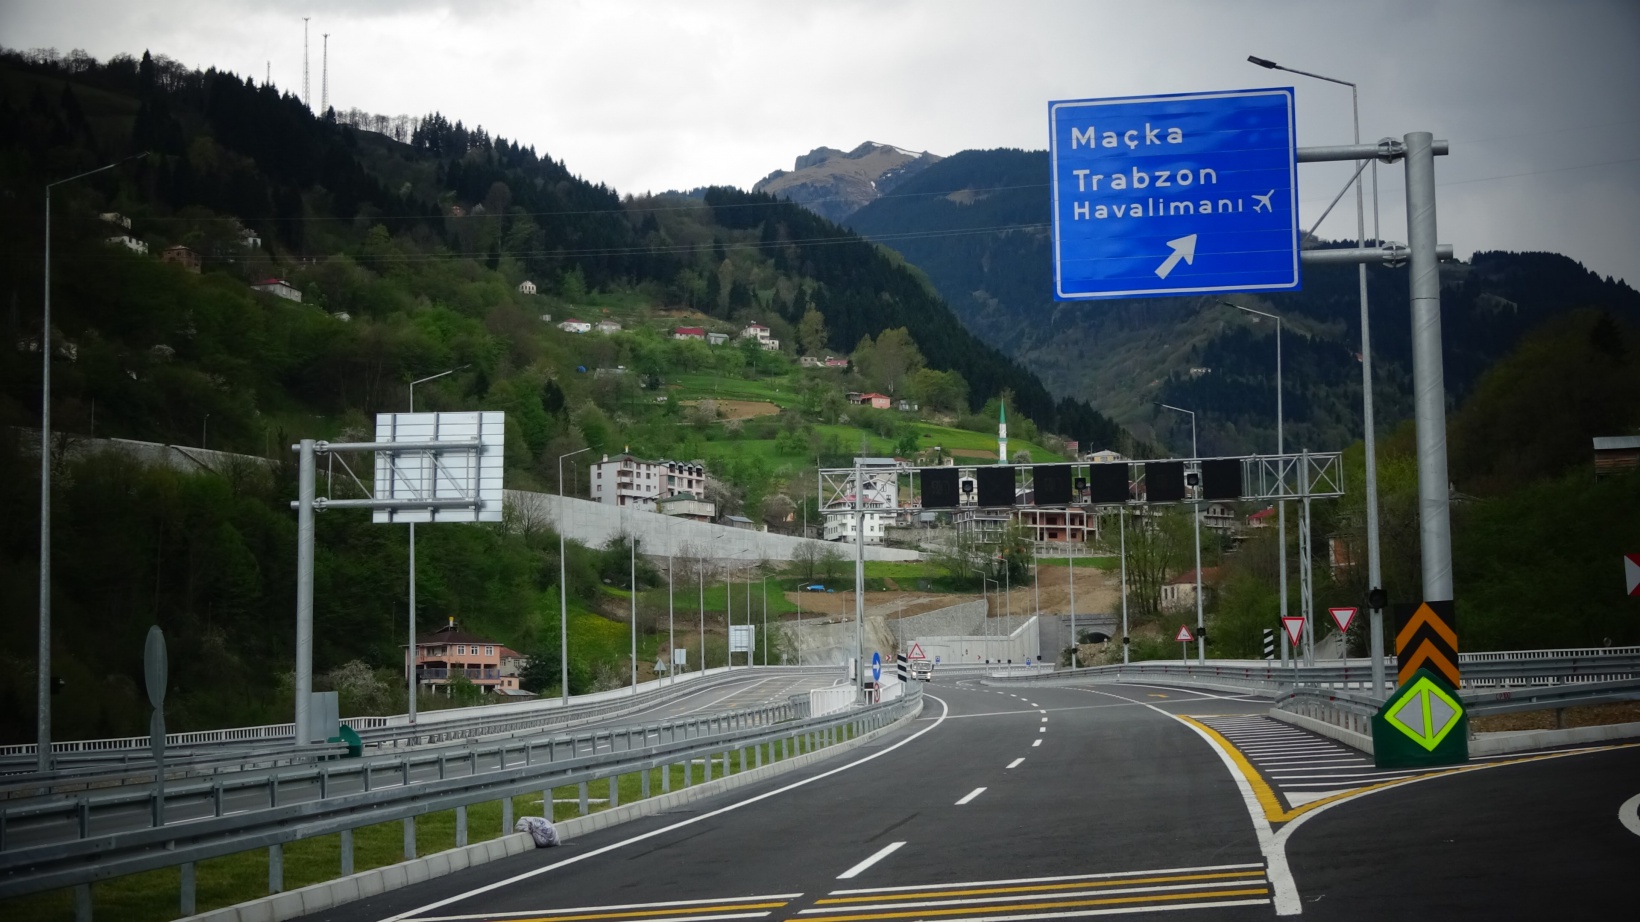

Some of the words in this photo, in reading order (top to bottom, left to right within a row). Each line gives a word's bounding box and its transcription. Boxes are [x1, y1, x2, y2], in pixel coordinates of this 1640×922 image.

[1071, 123, 1183, 150] Maçka
[1072, 167, 1217, 192] Trabzon
[1073, 198, 1243, 221] Havalimanı
